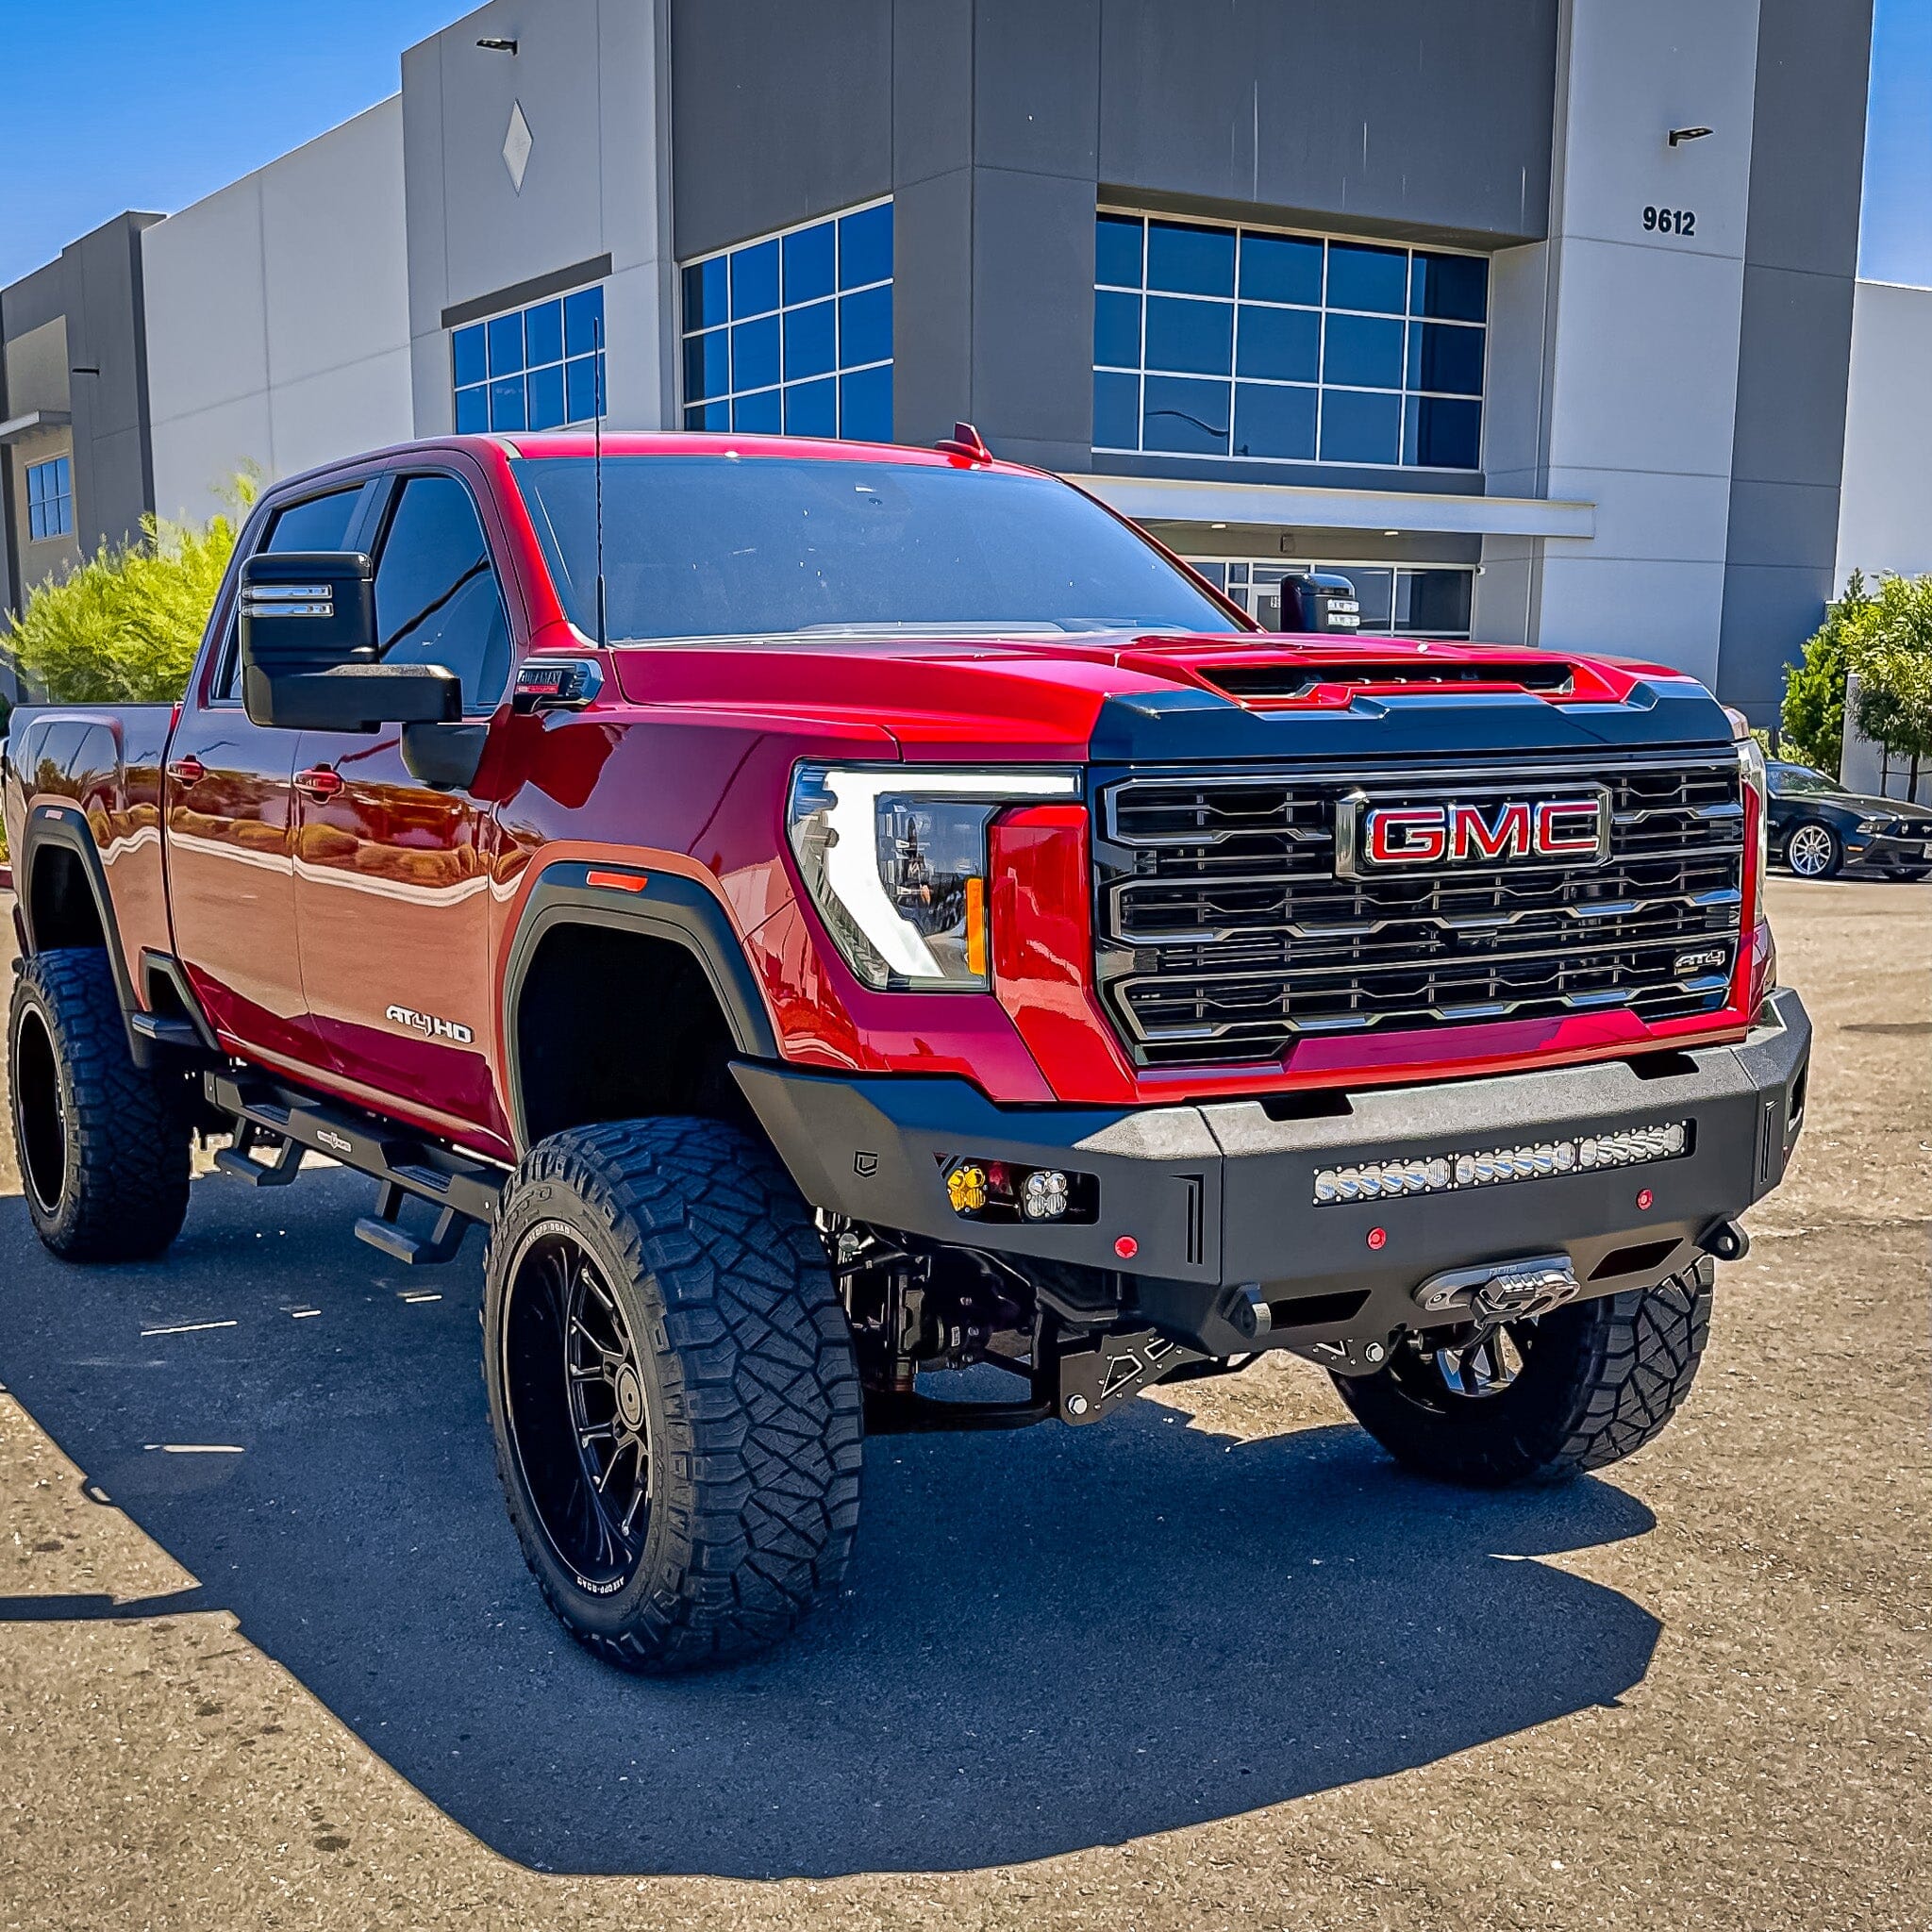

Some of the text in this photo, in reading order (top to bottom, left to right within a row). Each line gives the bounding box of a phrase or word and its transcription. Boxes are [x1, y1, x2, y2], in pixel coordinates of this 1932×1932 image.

[1642, 206, 1695, 236] 9612
[1365, 800, 1600, 865] GMC
[1674, 949, 1725, 968] AT4
[386, 1005, 474, 1043] AT4 HD
